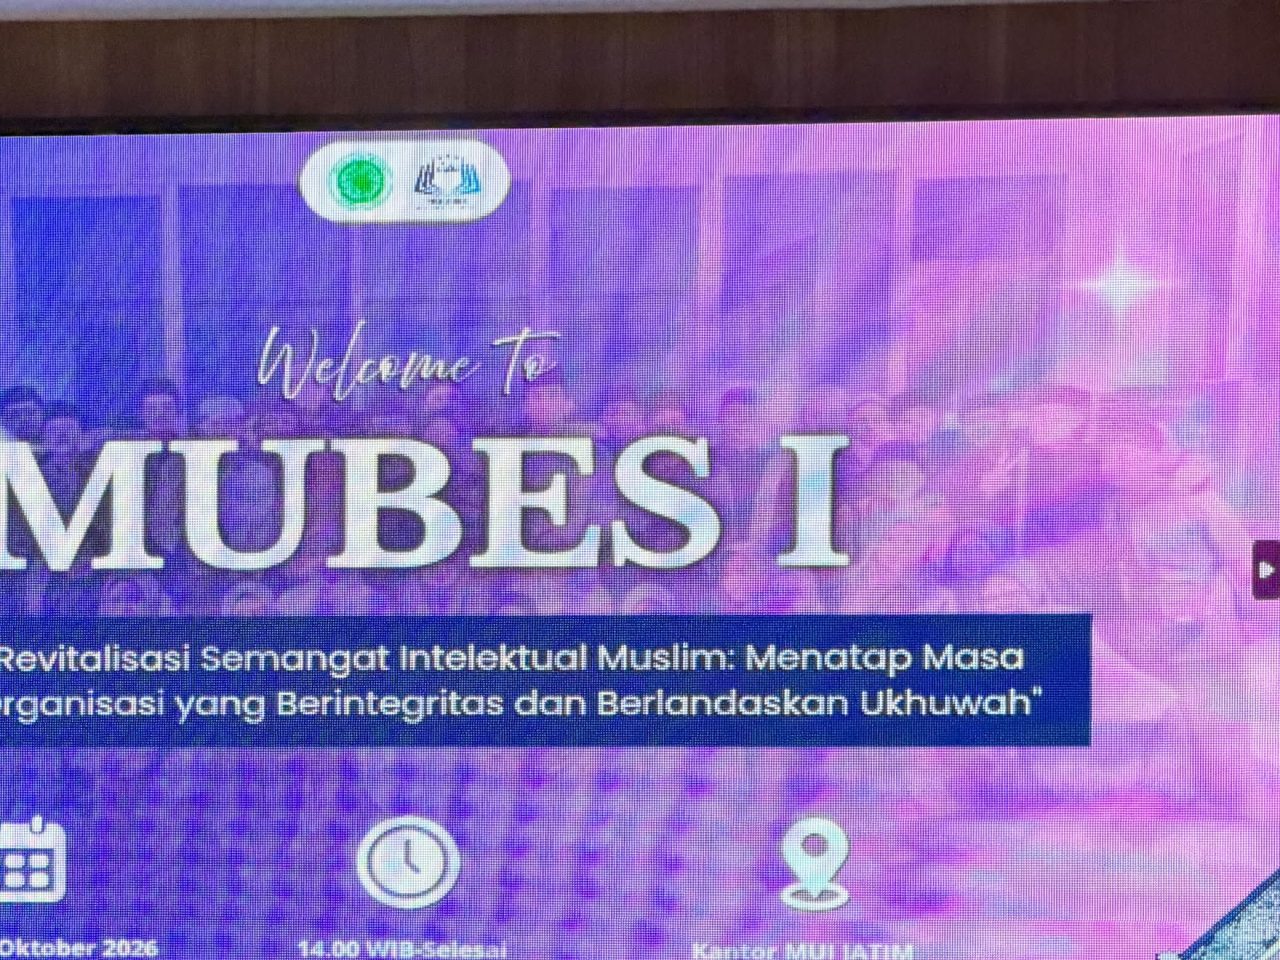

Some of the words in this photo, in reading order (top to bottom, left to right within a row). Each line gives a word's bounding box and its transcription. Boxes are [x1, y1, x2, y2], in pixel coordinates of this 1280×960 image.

[257, 319, 480, 401] Welcome
[492, 327, 561, 397] To
[780, 434, 851, 568] I
[201, 644, 390, 678] Semangat
[400, 643, 587, 671] Intelektual
[599, 642, 736, 671] Muslim:
[746, 644, 912, 678] Menatap
[924, 643, 1024, 671] Masa
[177, 694, 266, 724] yang
[278, 688, 504, 724] Berintegritas
[514, 688, 586, 716] dan
[599, 688, 849, 716] Berlandaskan
[860, 686, 1043, 716] Ukhuwah"
[102, 939, 159, 958] 2026
[298, 940, 361, 959] 14.00
